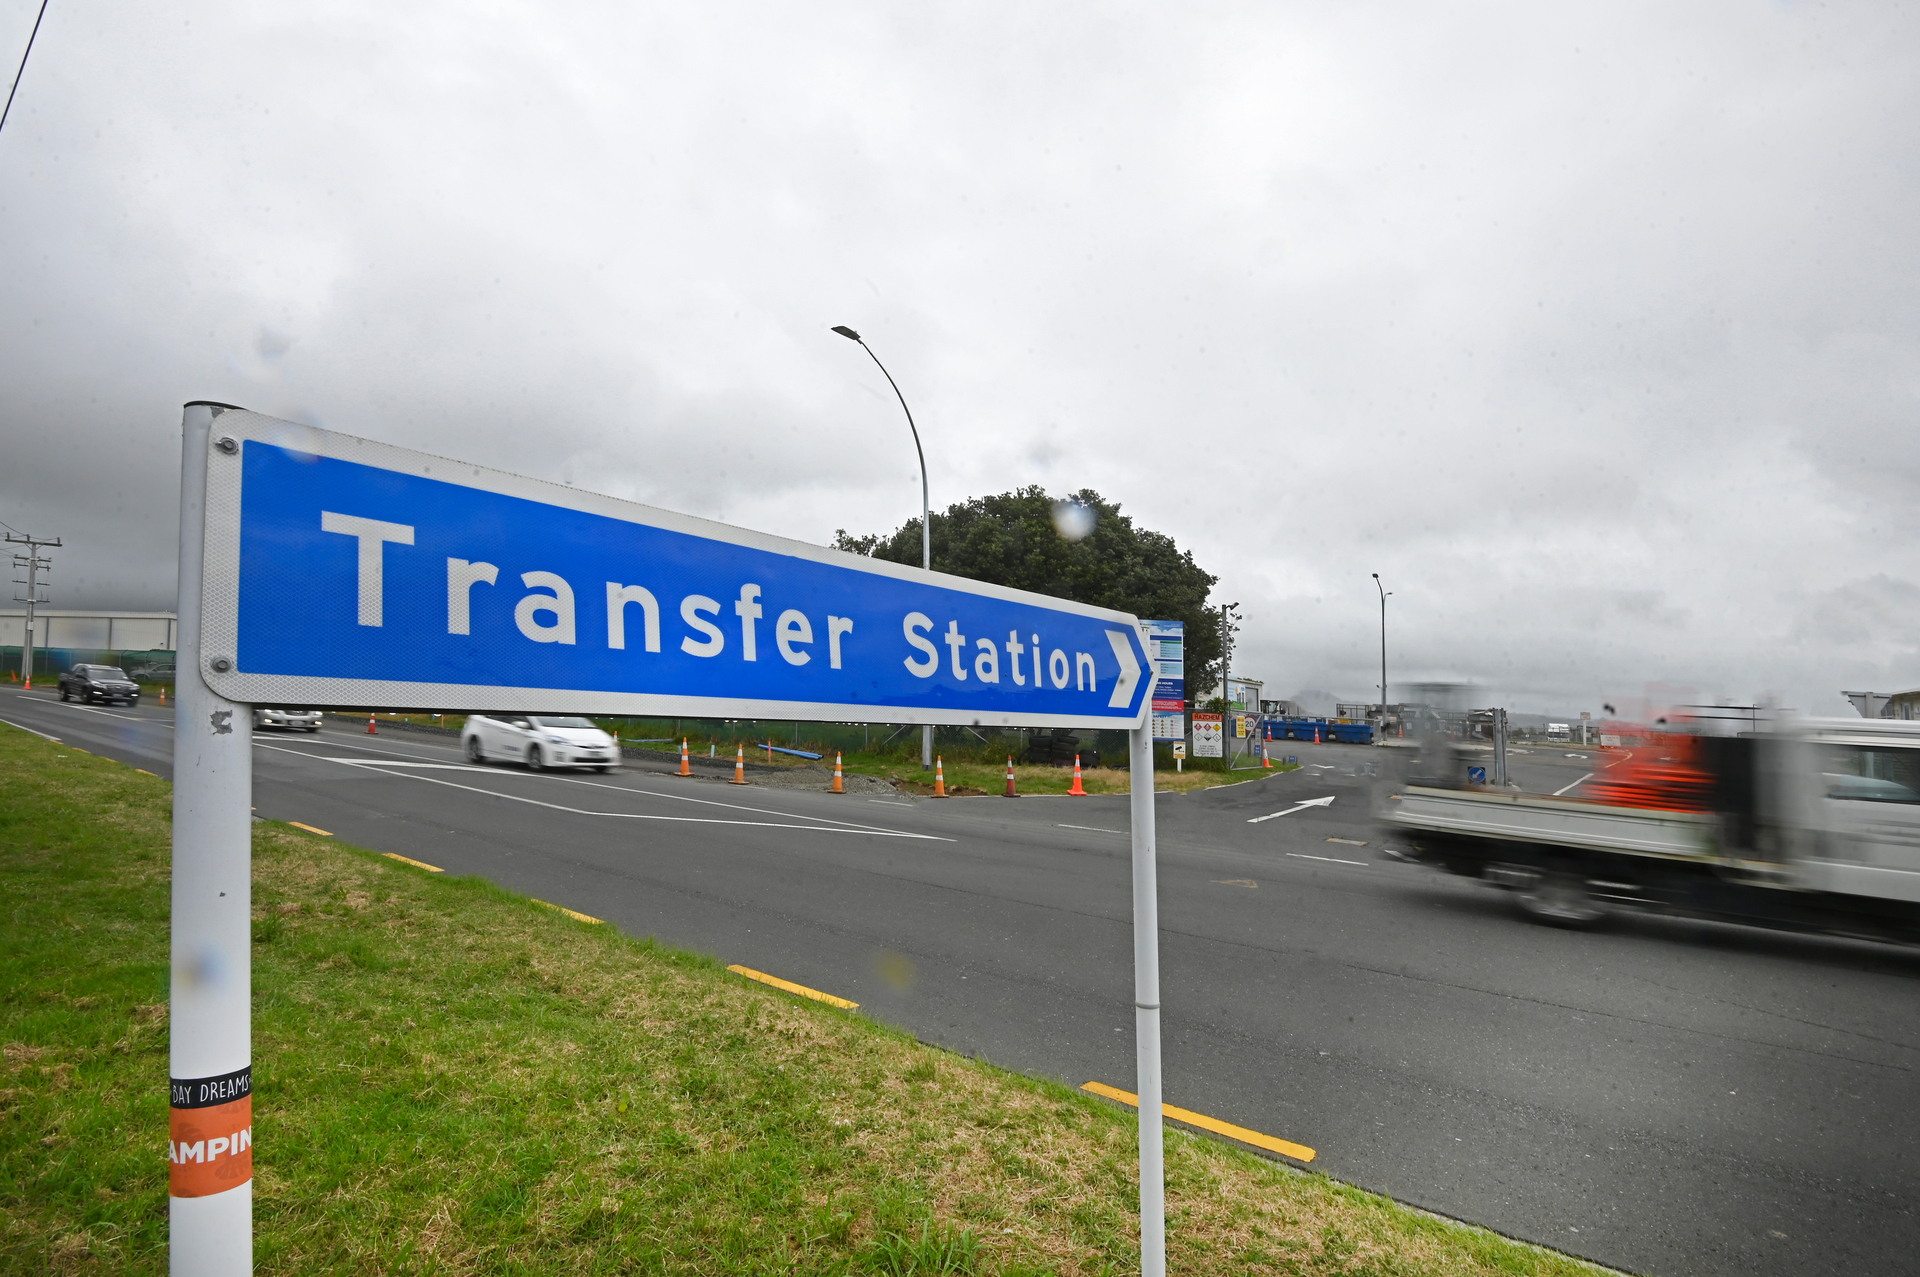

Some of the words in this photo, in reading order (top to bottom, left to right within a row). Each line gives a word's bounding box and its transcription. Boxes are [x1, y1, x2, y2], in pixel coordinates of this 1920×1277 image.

[321, 511, 854, 670] Transfer
[903, 612, 1097, 693] Station
[200, 1074, 249, 1102] DREAMS
